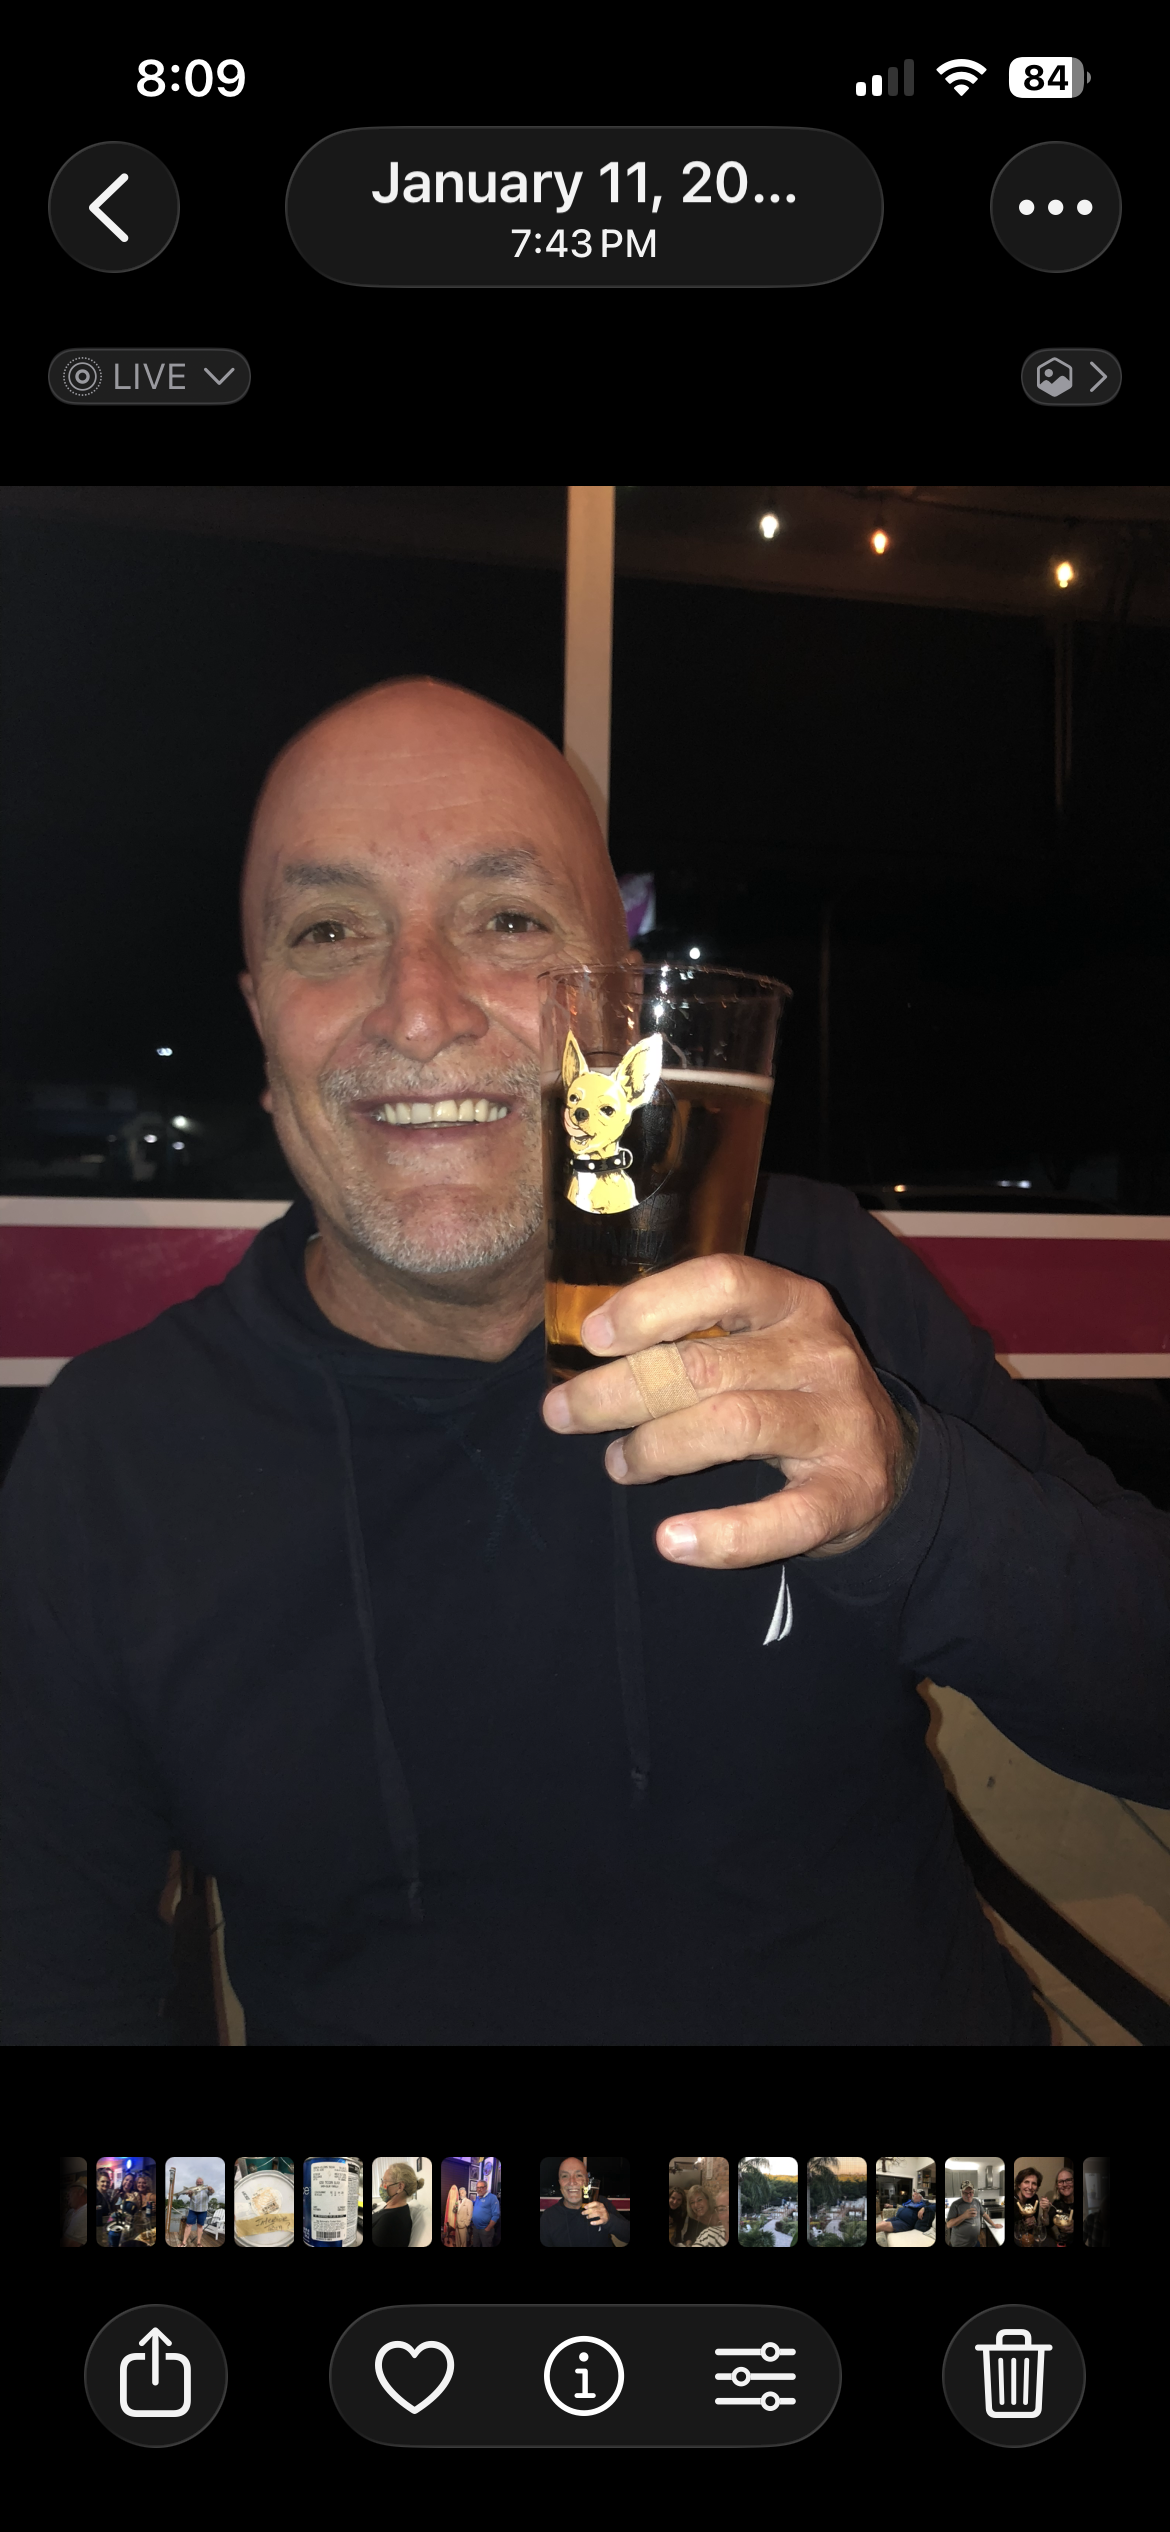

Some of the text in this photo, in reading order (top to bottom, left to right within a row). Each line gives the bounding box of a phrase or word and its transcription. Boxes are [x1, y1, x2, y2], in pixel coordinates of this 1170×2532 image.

[136, 58, 246, 98] 8:09
[1023, 64, 1069, 91] 84
[371, 161, 584, 214] January
[599, 161, 663, 214] 11,
[511, 228, 656, 259] 7:43 PM
[114, 363, 186, 390] LIVE
